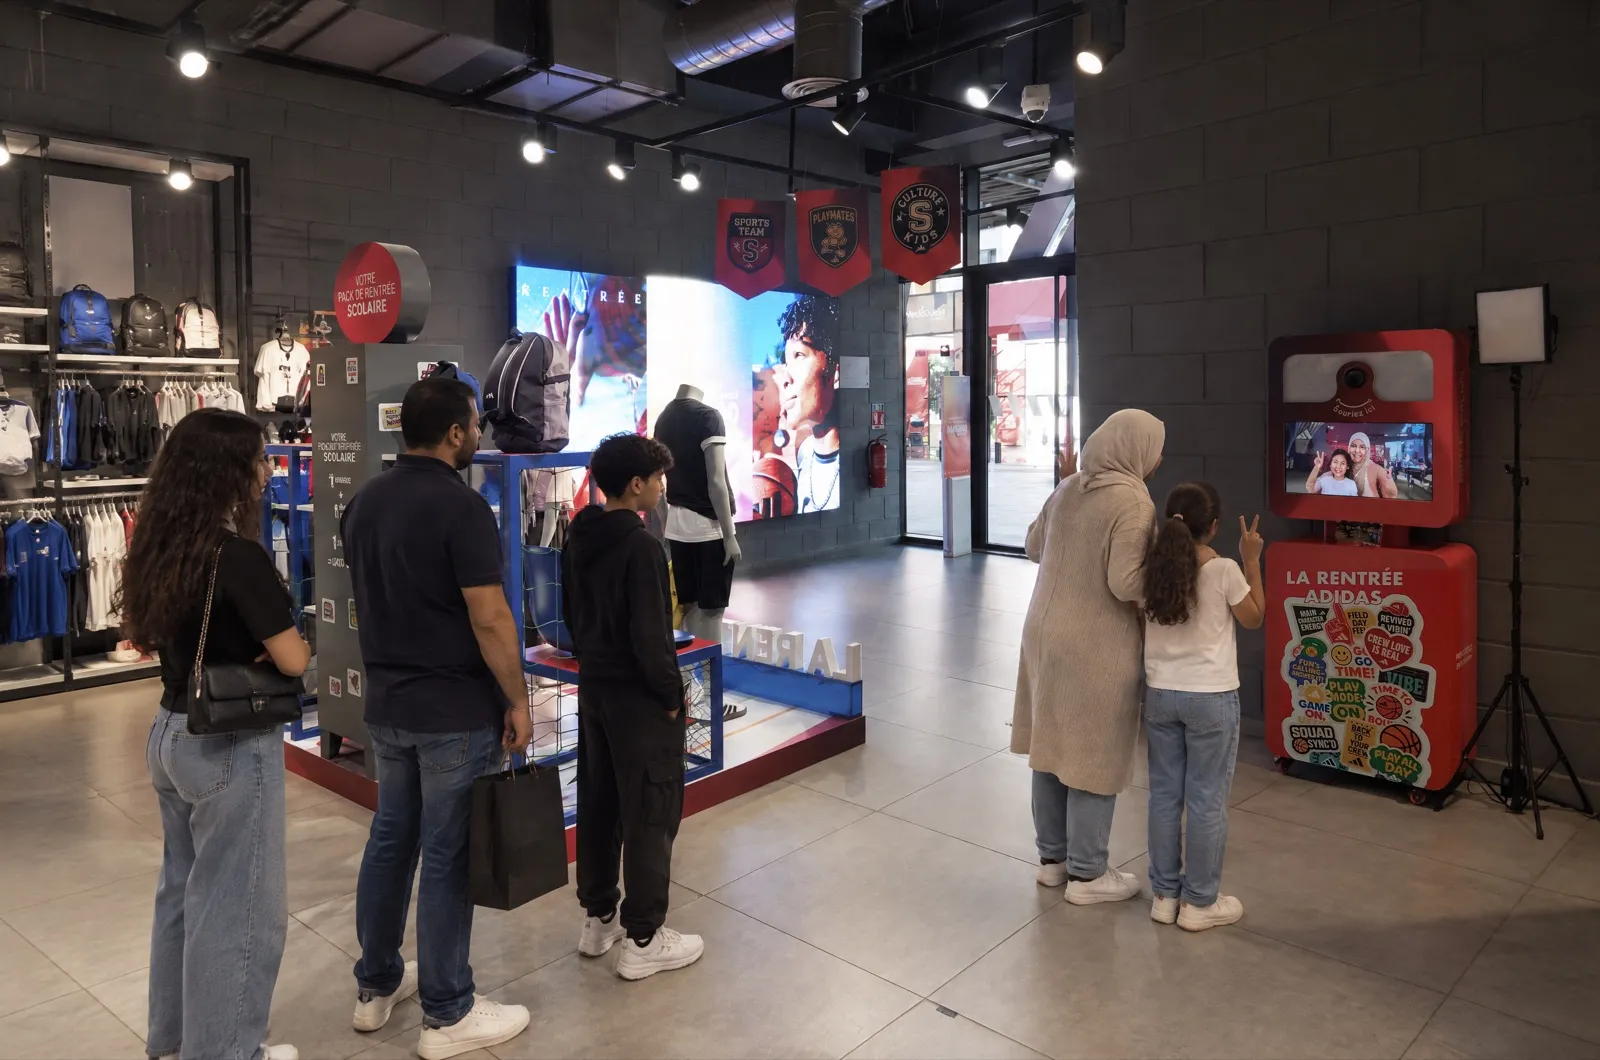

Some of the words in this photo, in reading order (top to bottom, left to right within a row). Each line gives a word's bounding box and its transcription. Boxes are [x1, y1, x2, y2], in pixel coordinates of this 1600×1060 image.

[897, 187, 944, 208] CULTURE
[734, 218, 770, 228] SPORTS
[812, 210, 855, 224] PLAYMATES
[908, 199, 934, 234] S
[738, 227, 765, 237] TEAM
[903, 229, 938, 245] KIDS
[742, 238, 759, 263] S
[354, 272, 376, 286] VOTRE
[338, 289, 354, 303] PACK
[355, 287, 364, 300] DE
[364, 281, 396, 299] RENTRÉE
[347, 299, 387, 318] SCOLAIRE
[323, 452, 356, 463] SCOLAIRE
[1286, 570, 1310, 585] LA
[1317, 567, 1404, 586] RENTRÉE
[1304, 589, 1382, 605] ADIDAS
[1300, 609, 1317, 618] MAIN
[1347, 611, 1369, 620] FIELD
[1352, 619, 1368, 627] DAY
[1380, 614, 1413, 627] REVIVED
[1367, 633, 1391, 648] CREW
[1391, 640, 1411, 655] LOVE
[1372, 645, 1380, 655] IS
[1381, 648, 1400, 662] REAL
[1355, 656, 1373, 666] GO
[1335, 667, 1376, 679] TIME!
[1329, 681, 1359, 692] PLAY
[1386, 671, 1424, 695] VIBE
[1371, 685, 1400, 696] TIME
[1400, 691, 1413, 706] TO
[1298, 700, 1331, 713] GAME
[1337, 706, 1360, 718] ON
[1304, 709, 1326, 722] ON,
[1291, 726, 1334, 739] SQUAD
[1351, 724, 1371, 735] BACK
[1308, 739, 1338, 749] SYNC'D
[1354, 733, 1363, 742] TO
[1350, 739, 1370, 750] YOUR
[1347, 746, 1369, 757] CREW
[1374, 749, 1400, 763] PLAY
[1401, 758, 1418, 771] ALL
[1385, 761, 1413, 778] DAY
